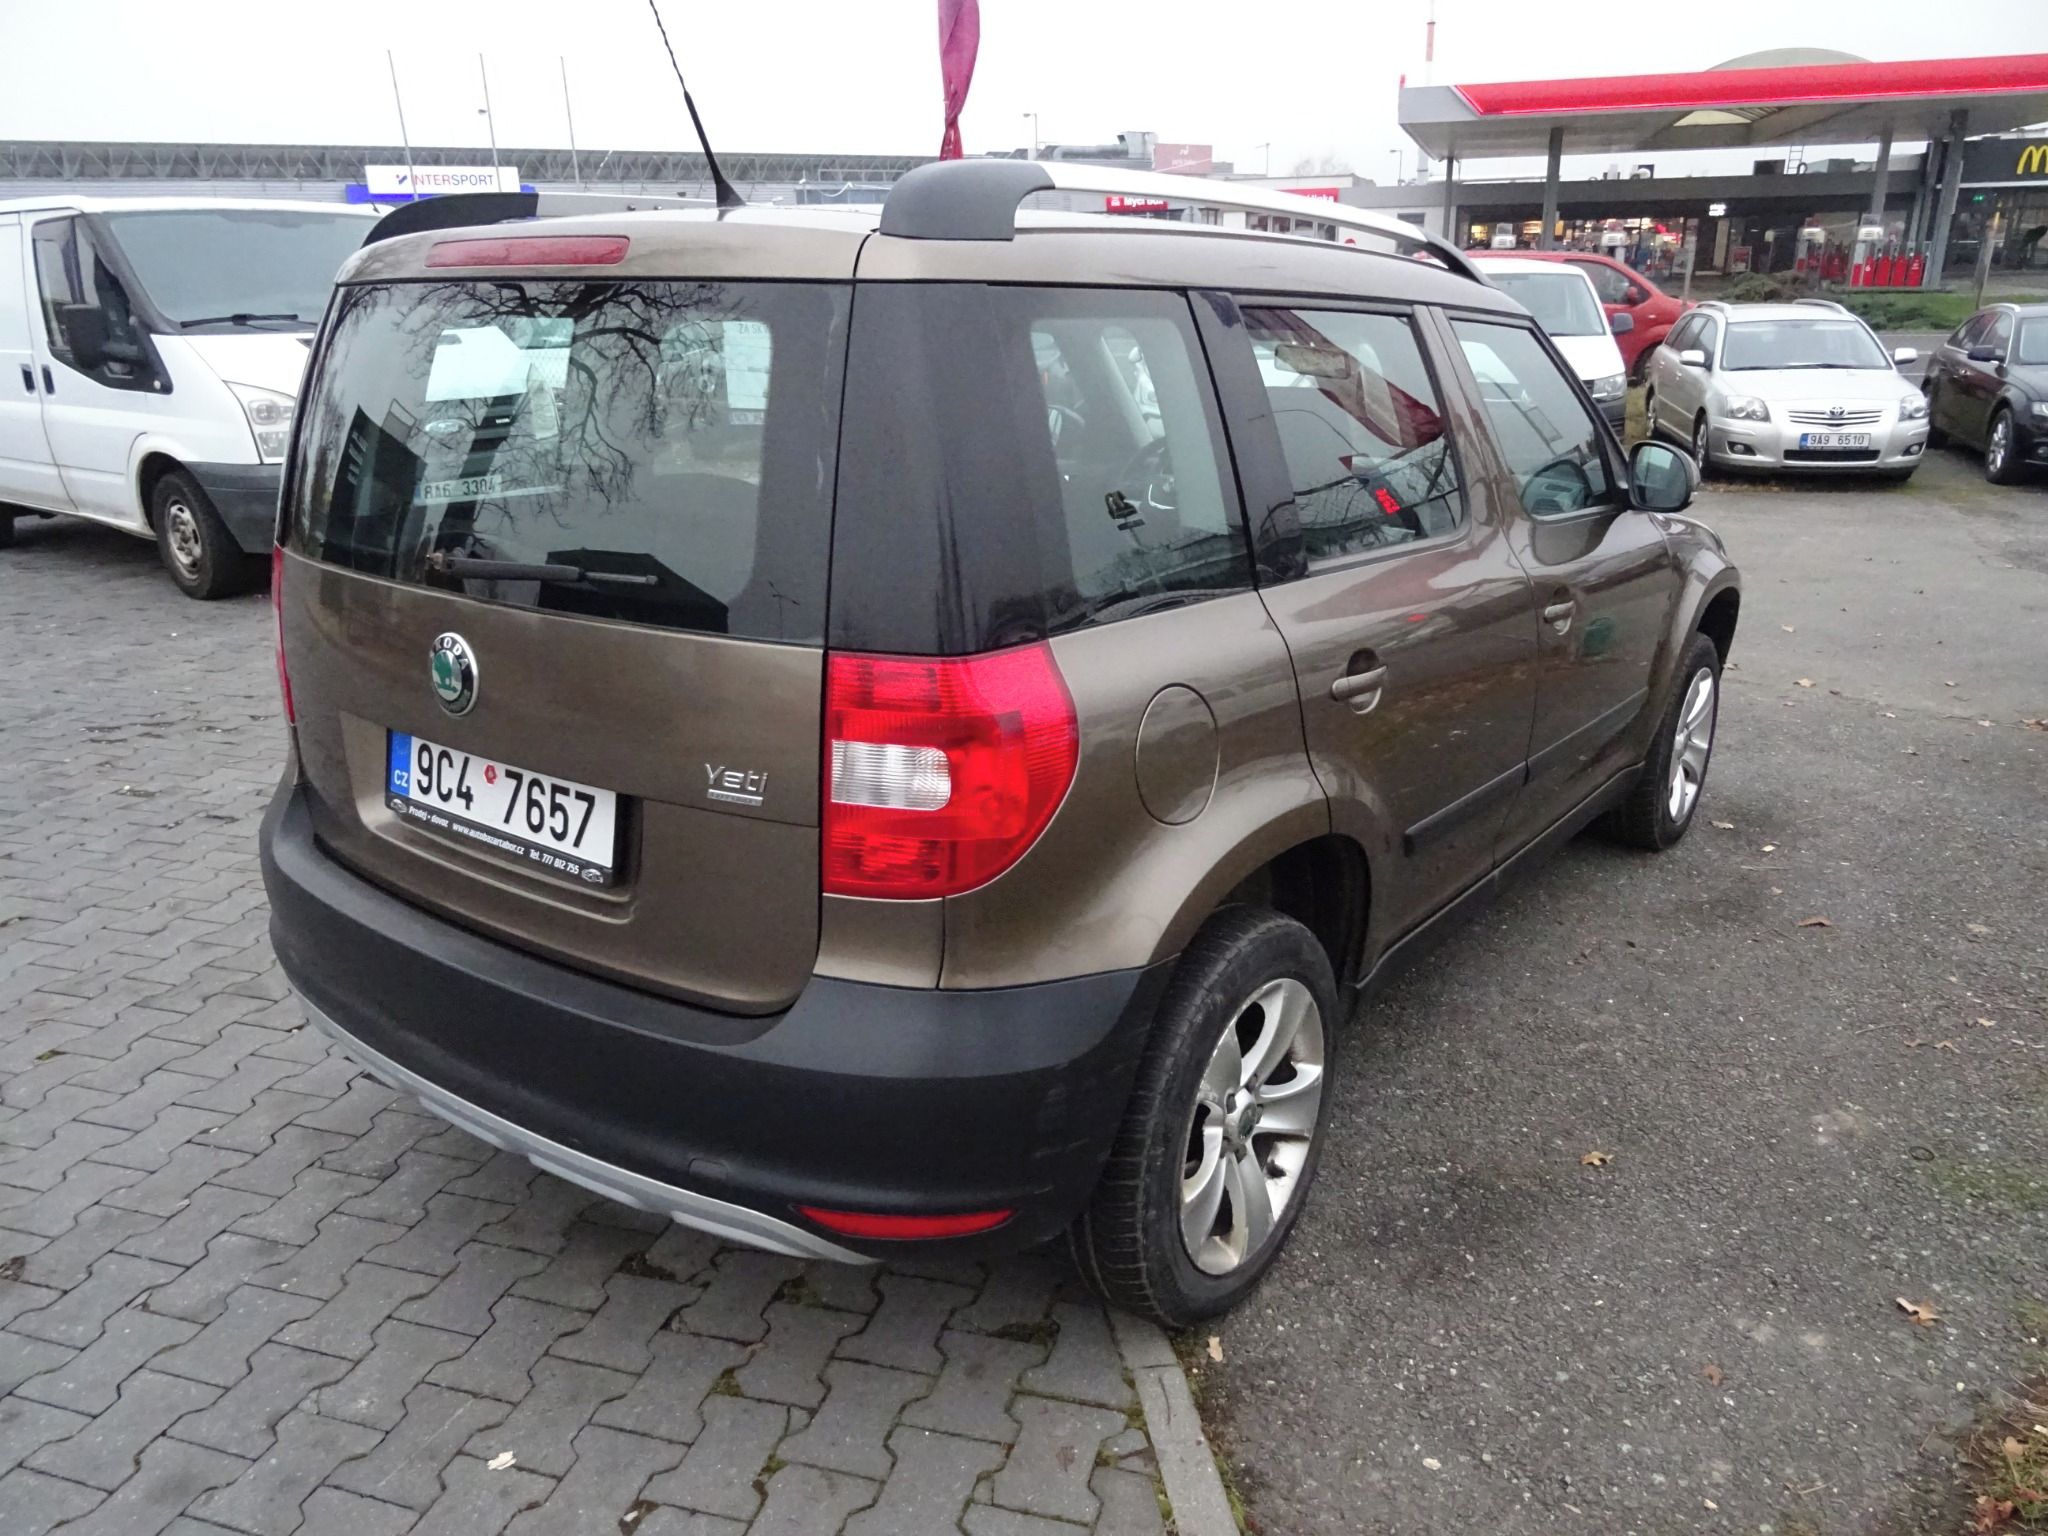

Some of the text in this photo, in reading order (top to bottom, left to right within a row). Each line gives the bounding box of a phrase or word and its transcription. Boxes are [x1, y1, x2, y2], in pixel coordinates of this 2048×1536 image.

[1810, 435, 1865, 445] 9A9 6510
[393, 769, 410, 788] CZ
[704, 763, 769, 793] Yeti
[416, 743, 596, 848] 9C4 7657
[541, 853, 554, 865] 777
[566, 862, 580, 875] 755
